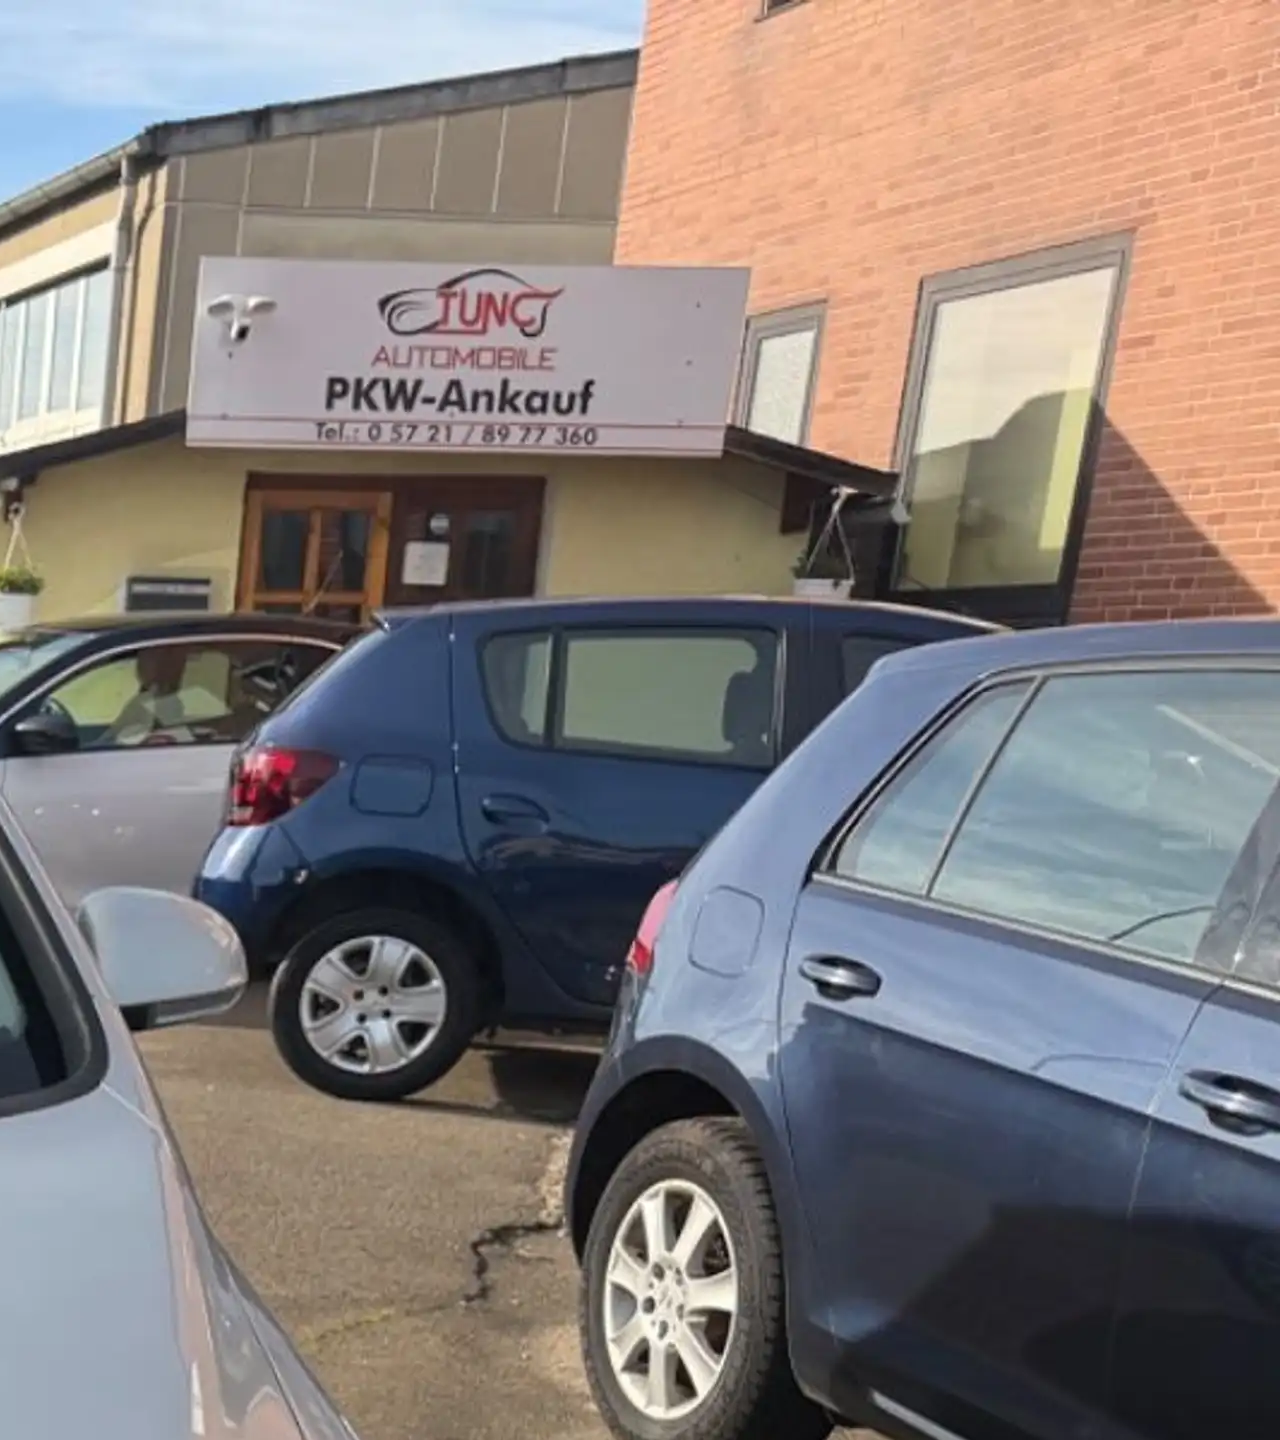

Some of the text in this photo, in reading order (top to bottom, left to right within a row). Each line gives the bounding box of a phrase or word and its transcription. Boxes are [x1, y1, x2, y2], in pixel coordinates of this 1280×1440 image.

[371, 345, 558, 371] AUTOMOBILE
[325, 376, 595, 415] PKW-Ankauf
[316, 422, 599, 446] Tel.: 0 57 21 / 89 77 360
